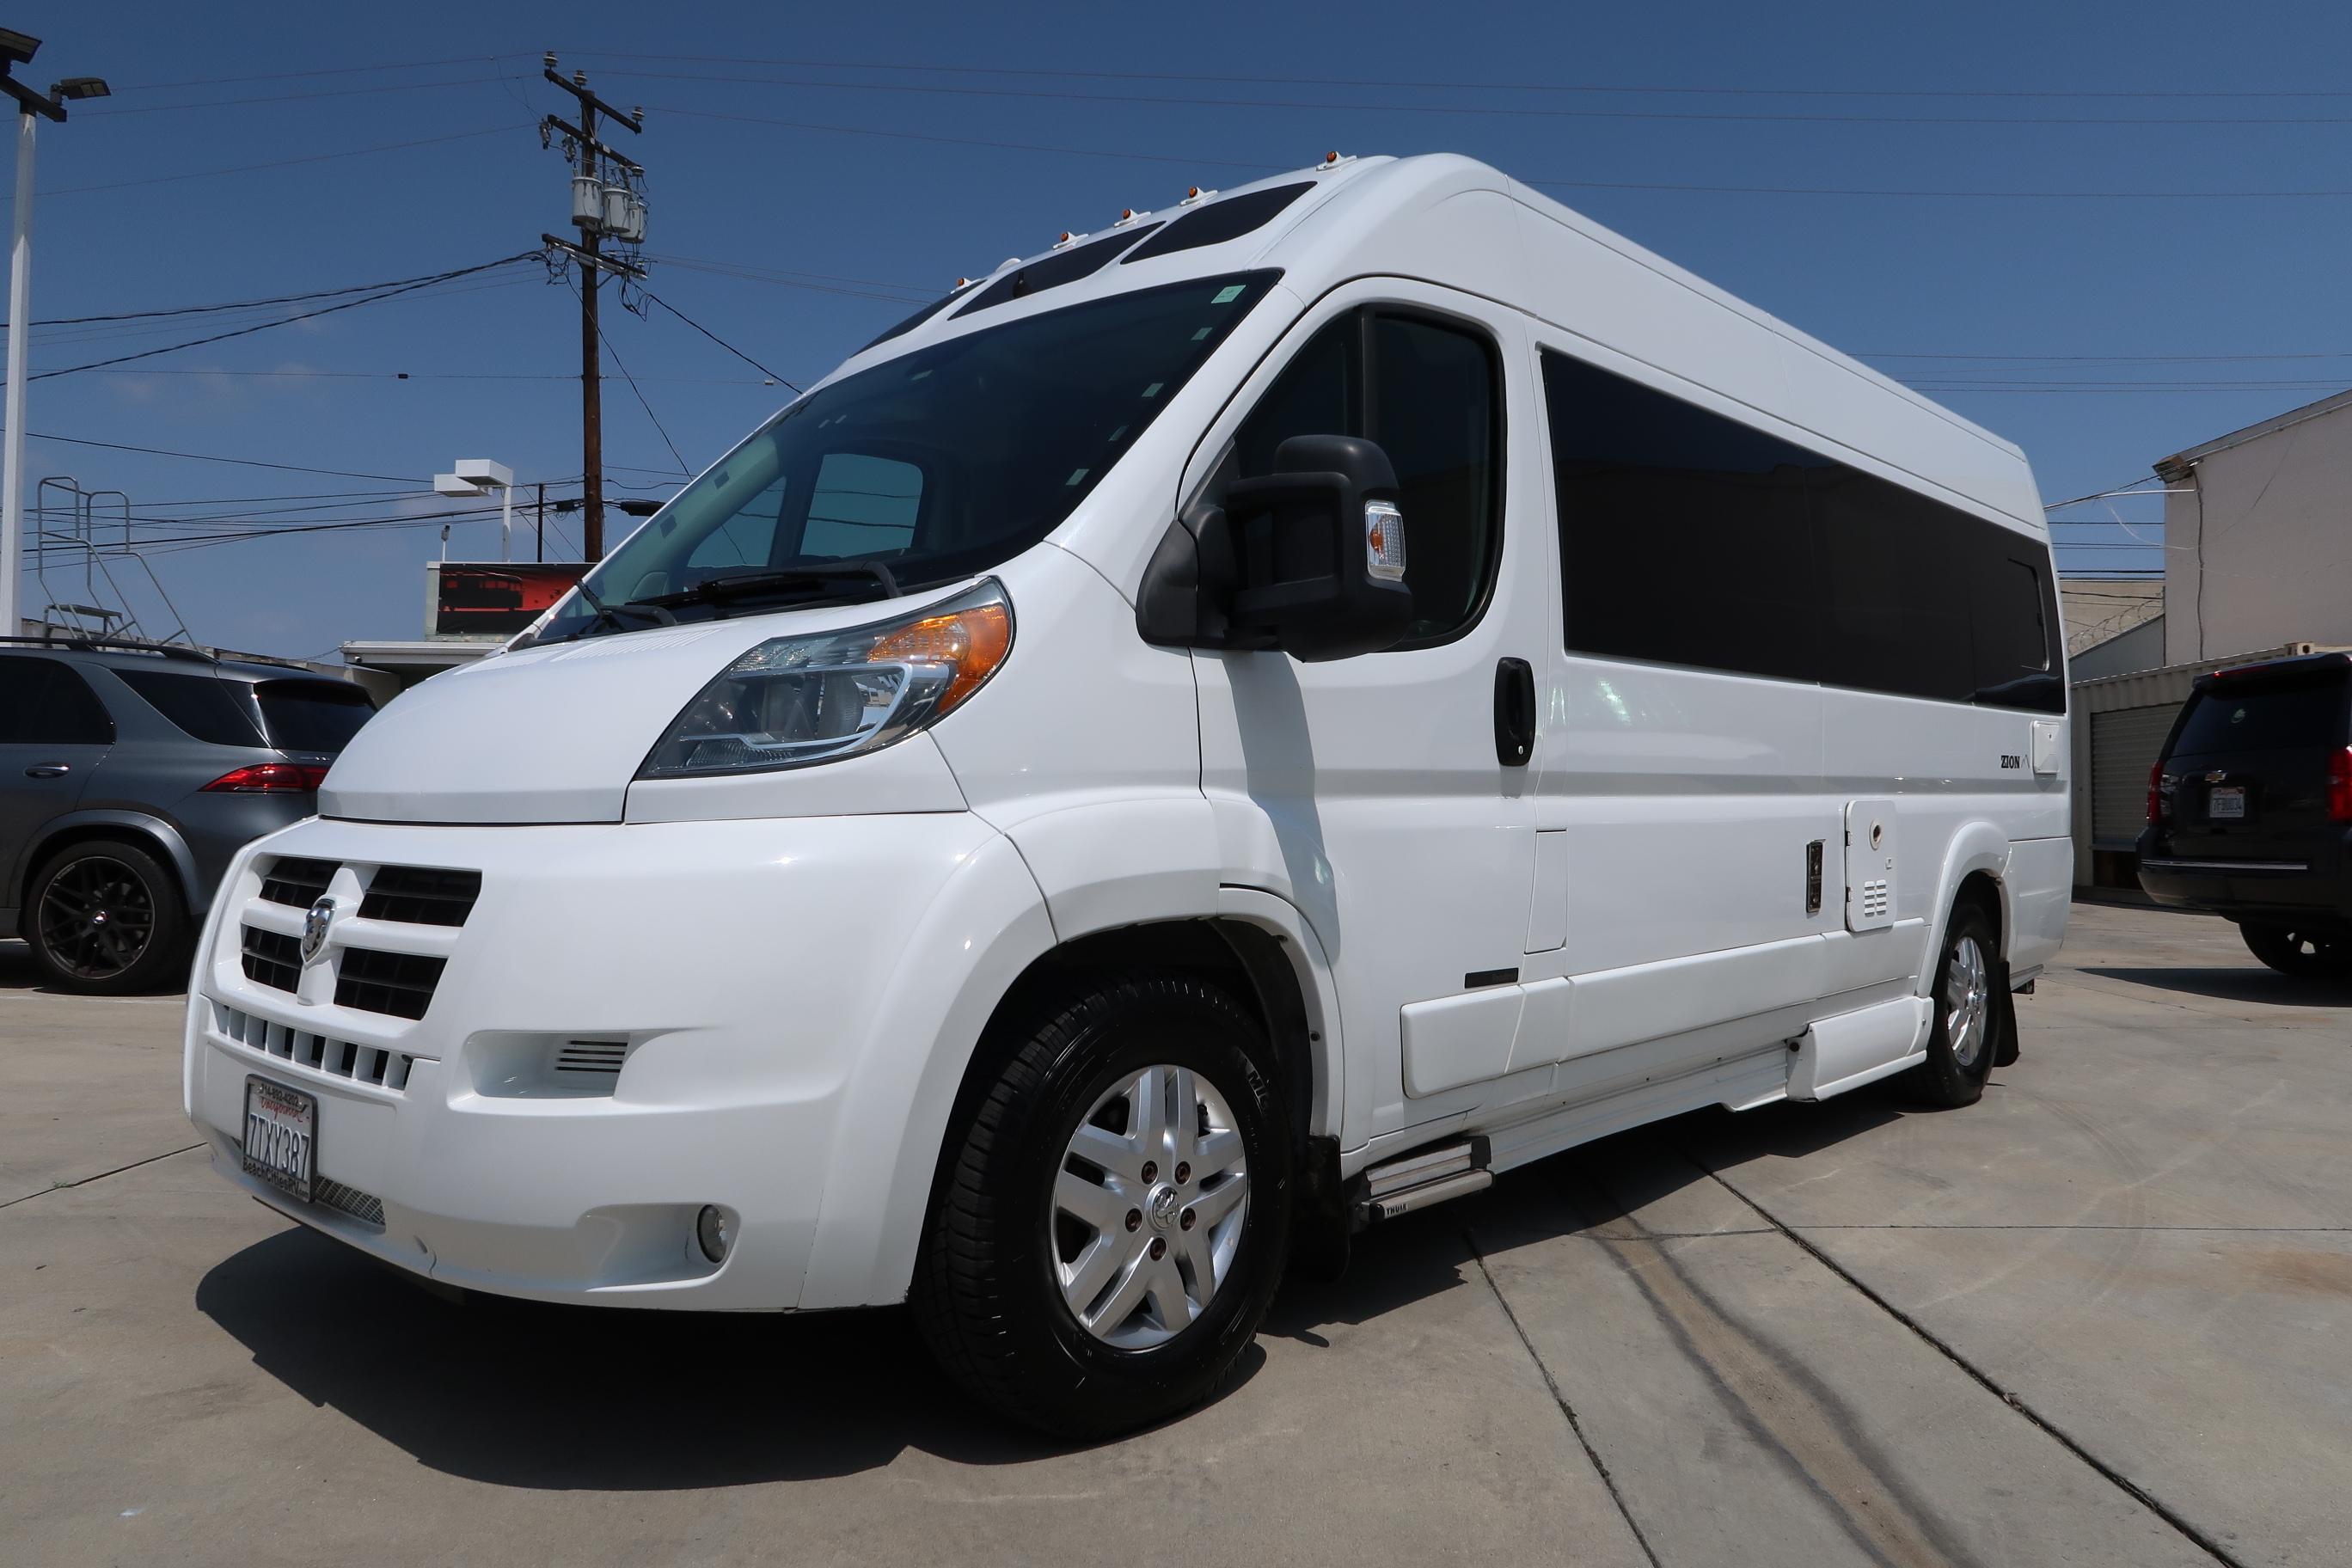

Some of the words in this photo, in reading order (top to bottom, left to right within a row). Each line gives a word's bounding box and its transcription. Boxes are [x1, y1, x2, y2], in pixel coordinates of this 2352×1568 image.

[2000, 755, 2020, 769] ZION
[249, 1112, 310, 1181] 7TXY387
[1386, 1203, 1407, 1216] THULE
